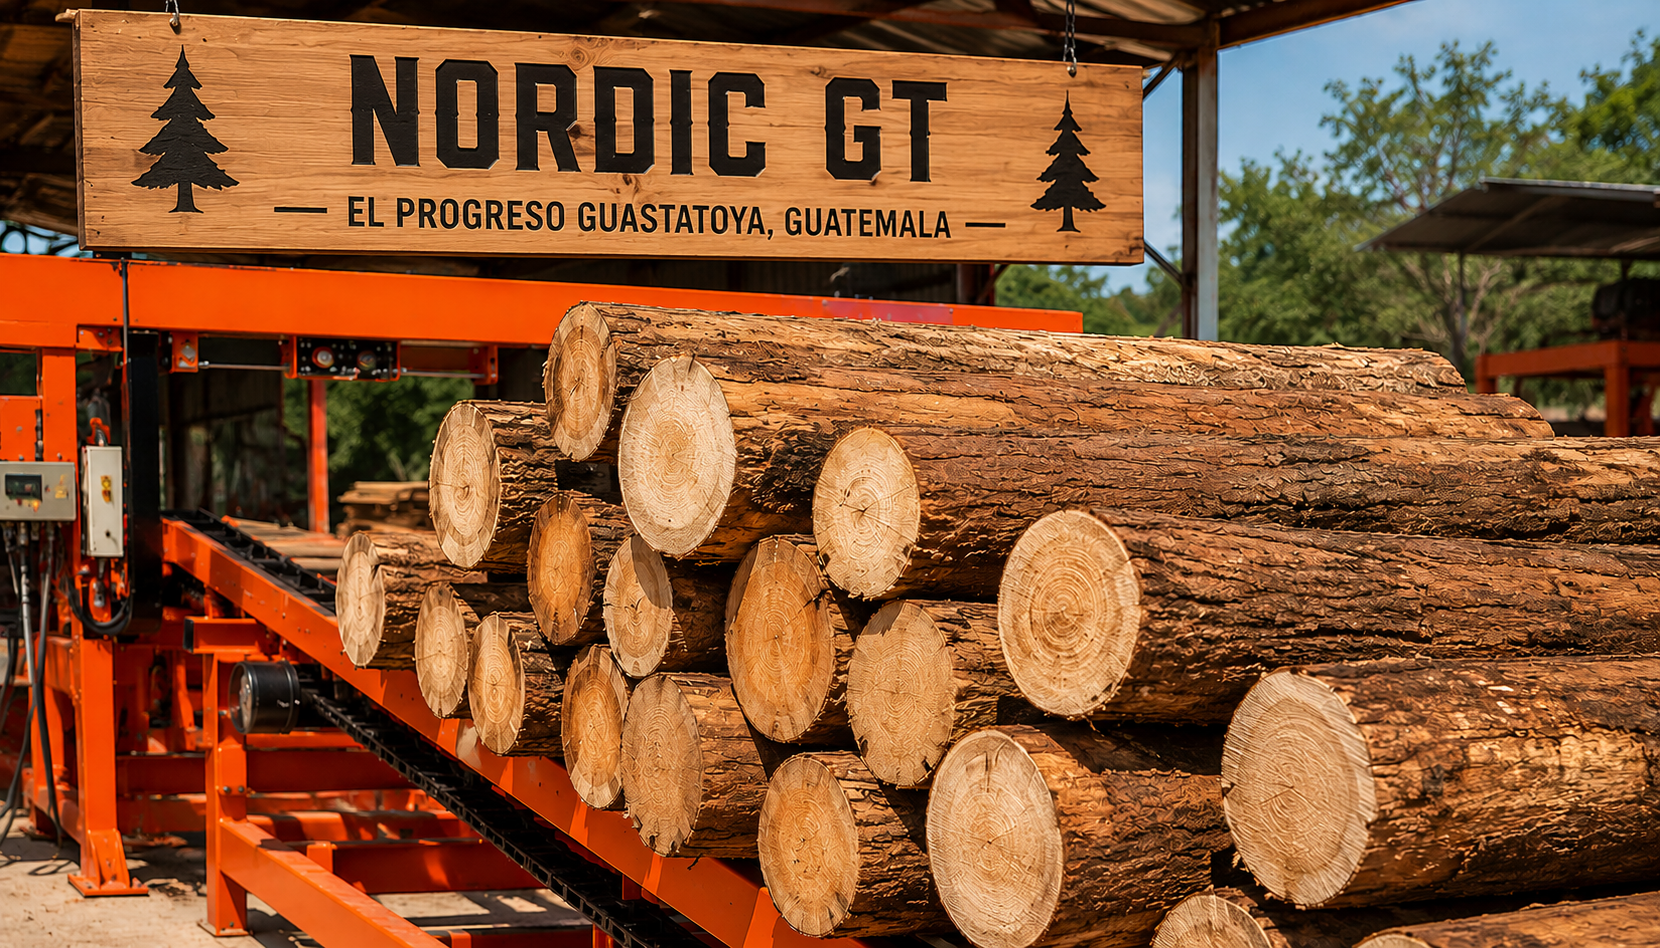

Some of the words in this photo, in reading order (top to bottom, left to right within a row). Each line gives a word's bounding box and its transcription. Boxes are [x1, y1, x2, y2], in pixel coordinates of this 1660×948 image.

[349, 54, 766, 178] NORDIC
[824, 77, 948, 183] GT
[348, 196, 385, 228] EL
[396, 198, 565, 232] PROGRESO
[577, 202, 774, 240] GUASTATOYA,
[785, 207, 952, 239] GUATEMALA
